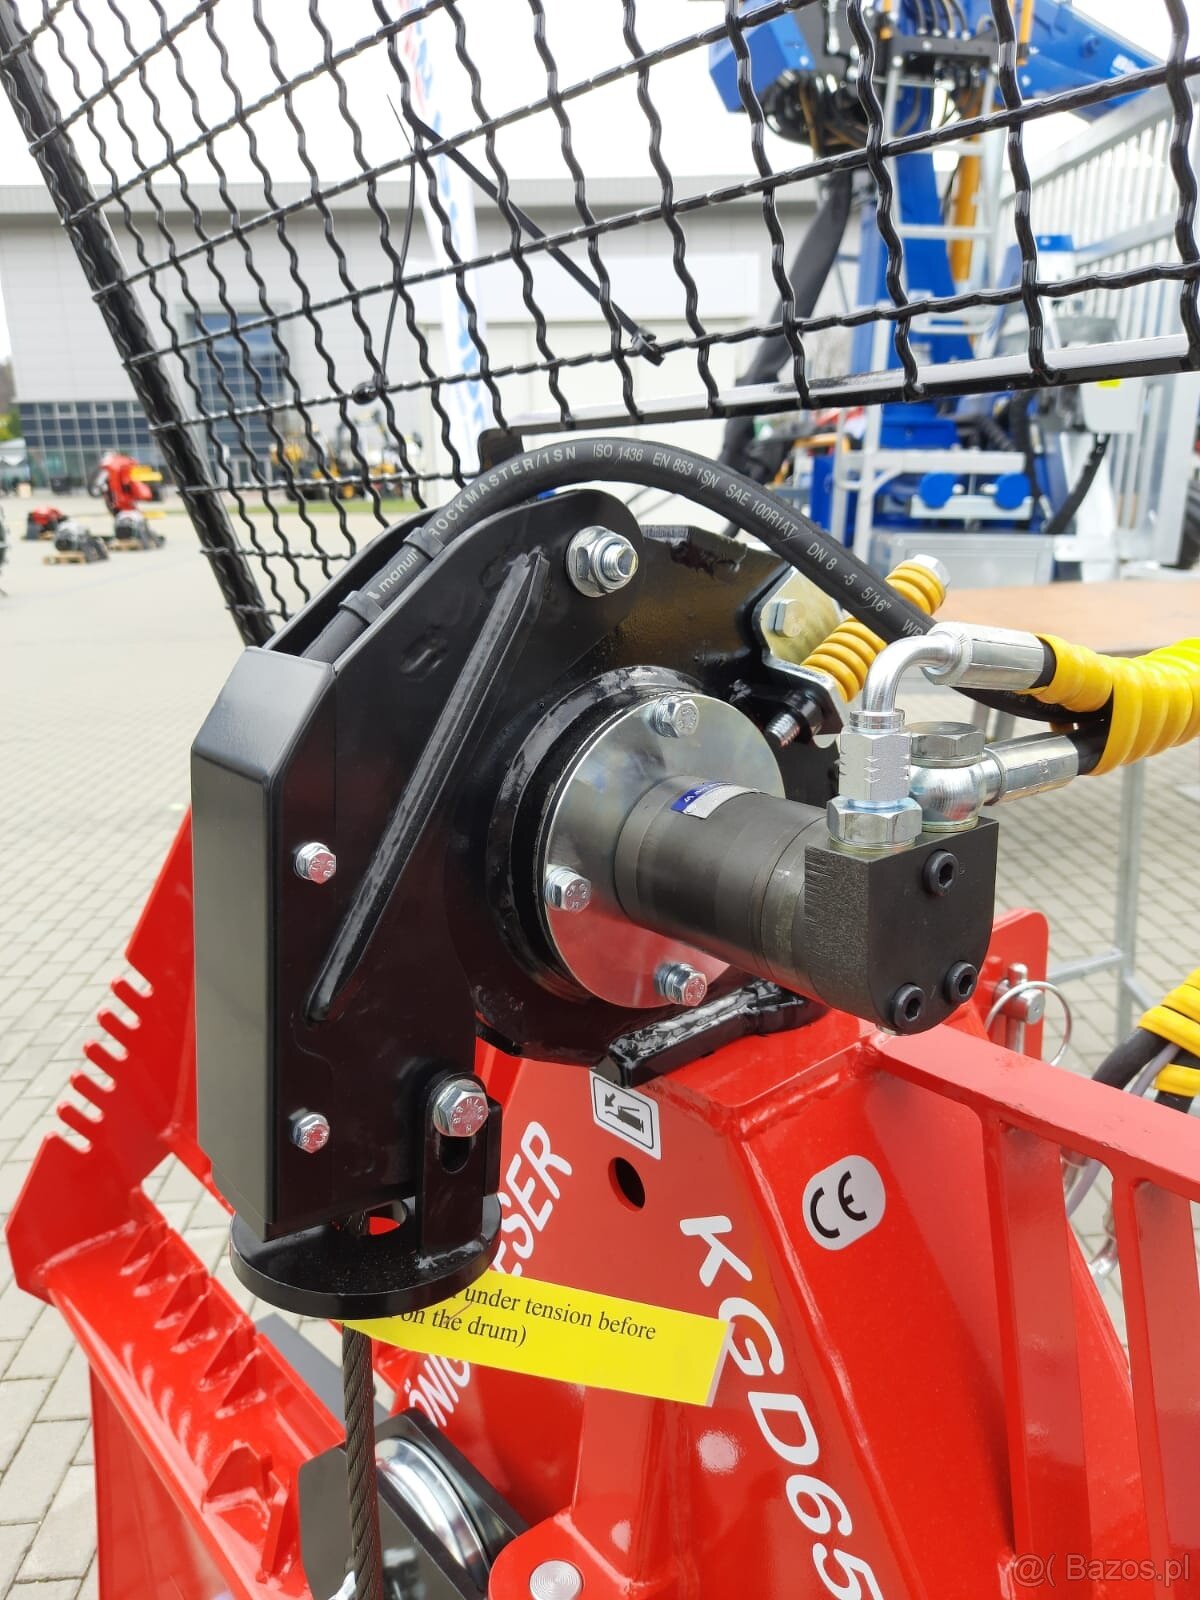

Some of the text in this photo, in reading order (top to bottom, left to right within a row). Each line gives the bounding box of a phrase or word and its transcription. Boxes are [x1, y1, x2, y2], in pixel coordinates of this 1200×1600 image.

[593, 444, 613, 458] ISO
[619, 446, 643, 462] 1436
[653, 452, 670, 468] EN
[672, 459, 693, 475] 853
[697, 468, 720, 488] 1SN
[725, 483, 751, 506] SAE
[750, 500, 798, 538] 100R1AT
[806, 542, 826, 564] DN
[825, 557, 838, 571] 8
[810, 1170, 867, 1239] CE
[431, 1308, 462, 1331] the
[467, 1315, 527, 1349] drum)
[464, 1287, 521, 1311] under
[525, 1298, 593, 1327] tension
[598, 1312, 656, 1340] before
